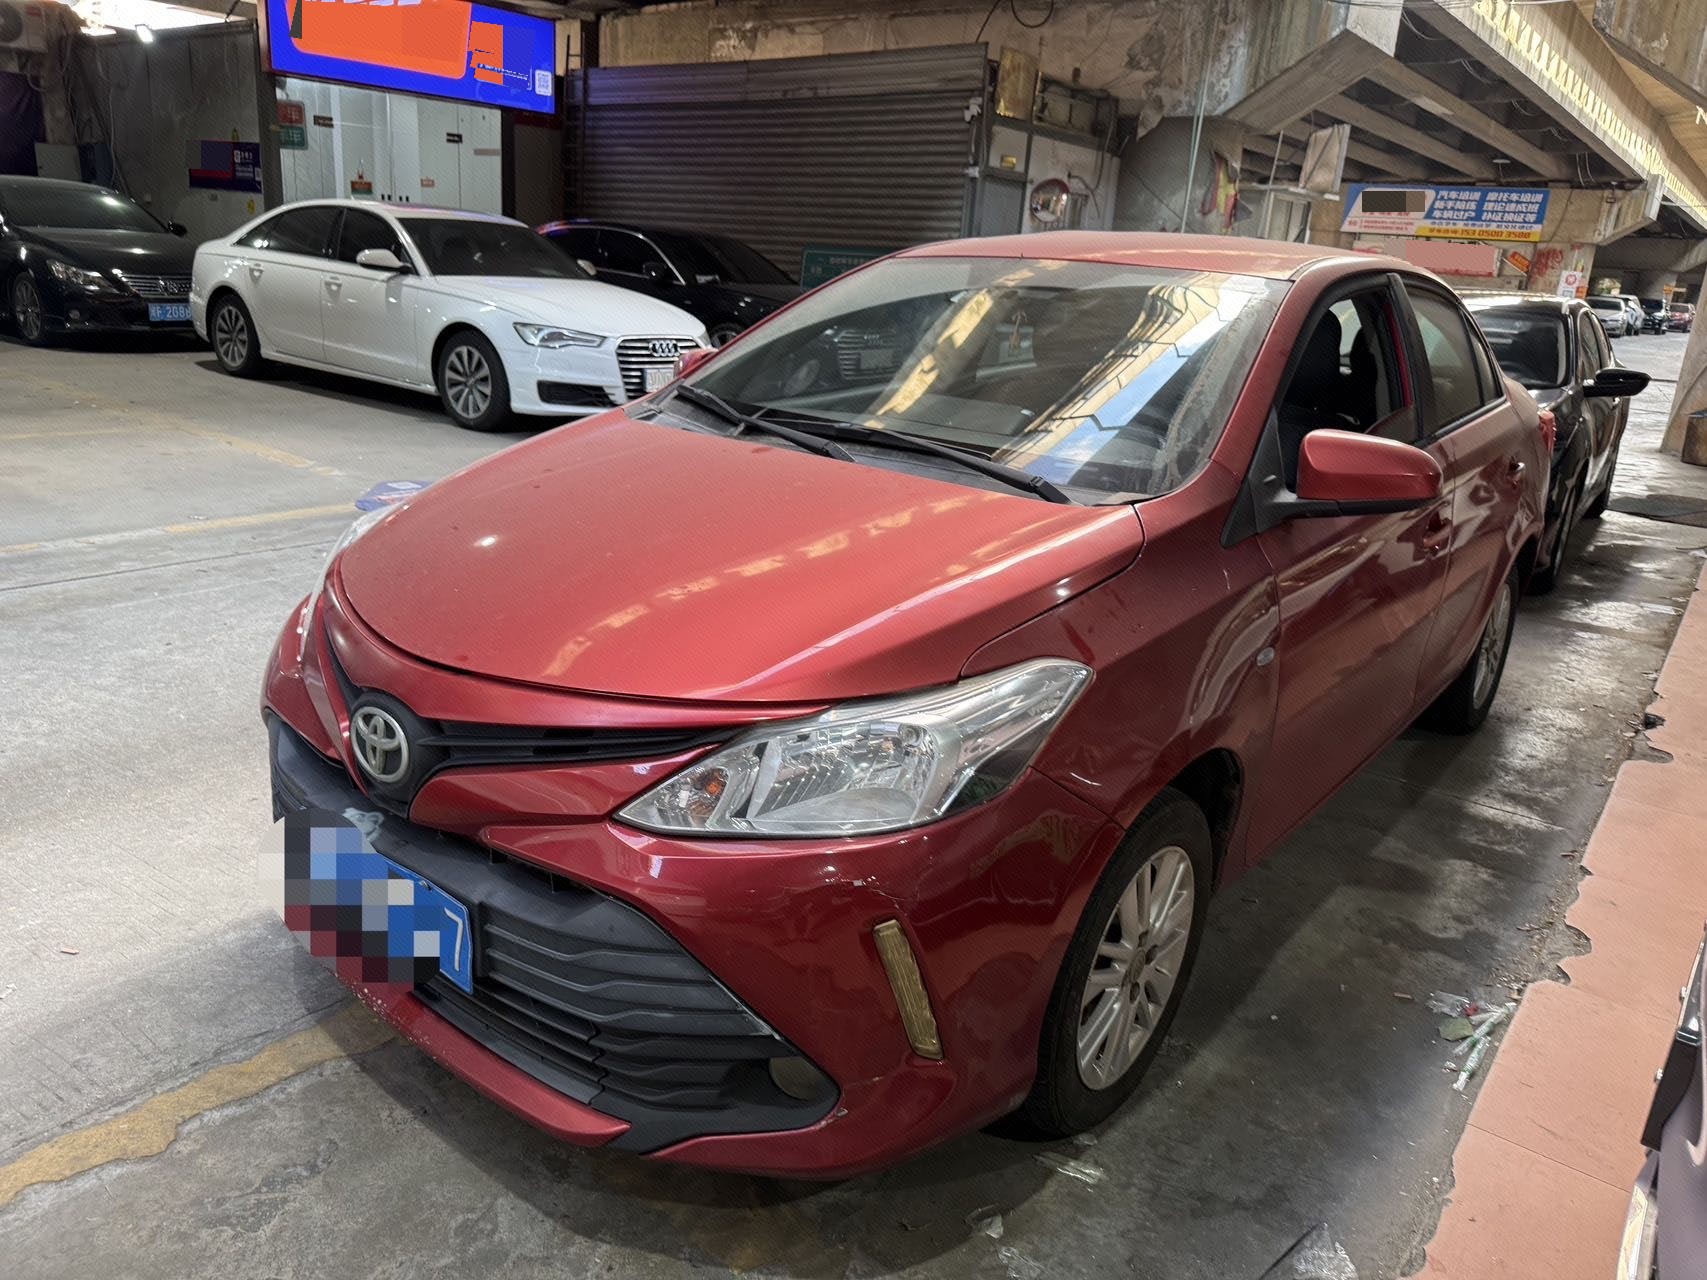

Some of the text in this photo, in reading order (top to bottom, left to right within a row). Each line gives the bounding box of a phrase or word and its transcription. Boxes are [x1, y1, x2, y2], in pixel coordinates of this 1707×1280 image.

[1437, 190, 1543, 202] 汽车培训 摩托车培训
[1432, 210, 1476, 219] 车辆过户
